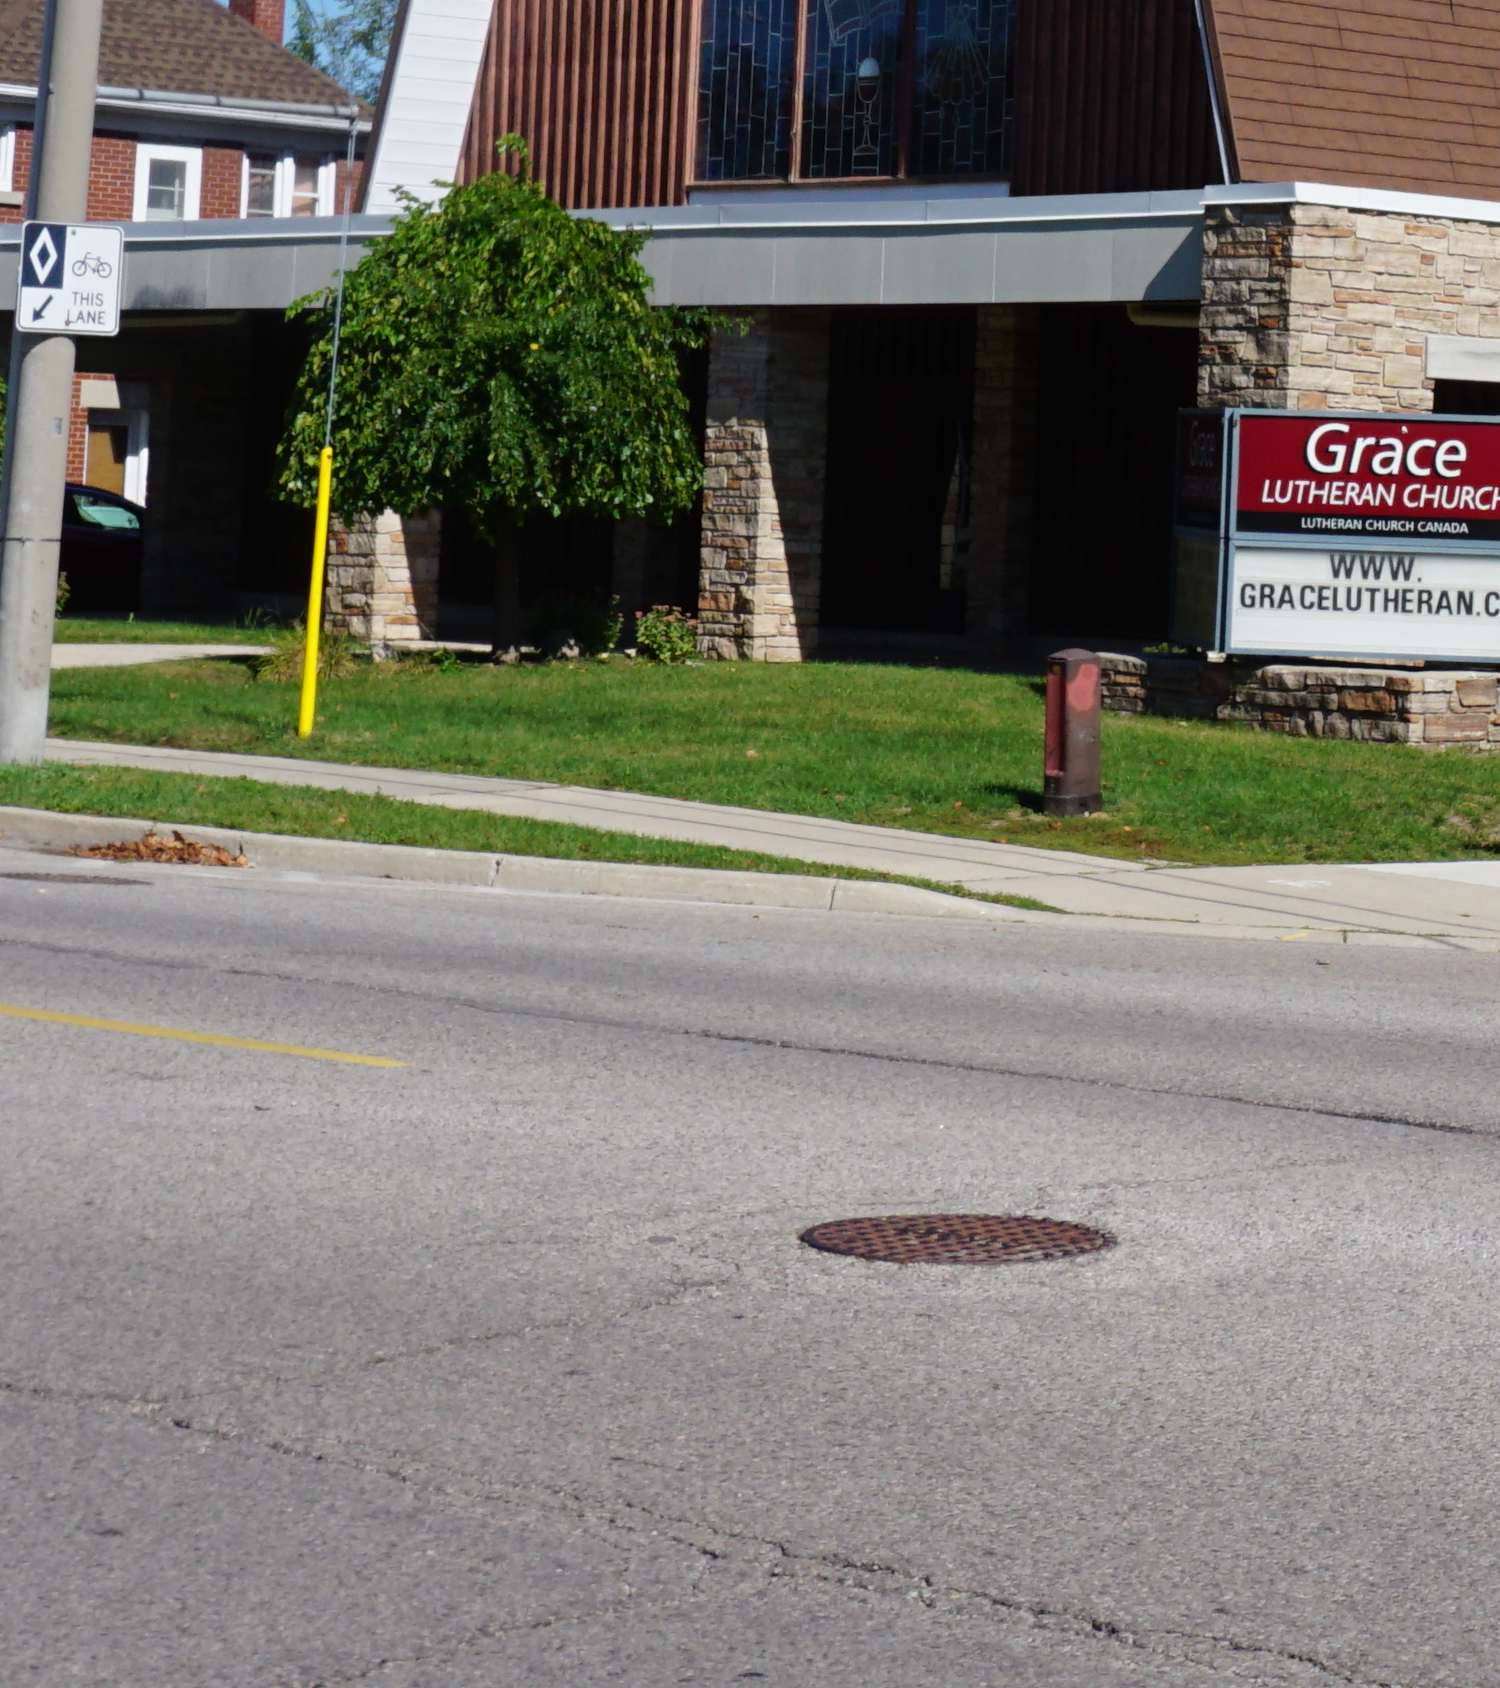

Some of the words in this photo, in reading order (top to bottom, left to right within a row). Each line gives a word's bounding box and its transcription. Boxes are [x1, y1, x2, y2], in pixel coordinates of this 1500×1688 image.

[72, 291, 104, 307] THIS
[66, 309, 106, 325] LANE
[1306, 423, 1467, 478] Grace
[1262, 479, 1396, 506] LUTHERAN
[1301, 517, 1362, 530] LUTHERAN
[1365, 519, 1414, 532] CHURCH
[1417, 521, 1469, 534] CANADA
[1329, 554, 1422, 582] WWW.
